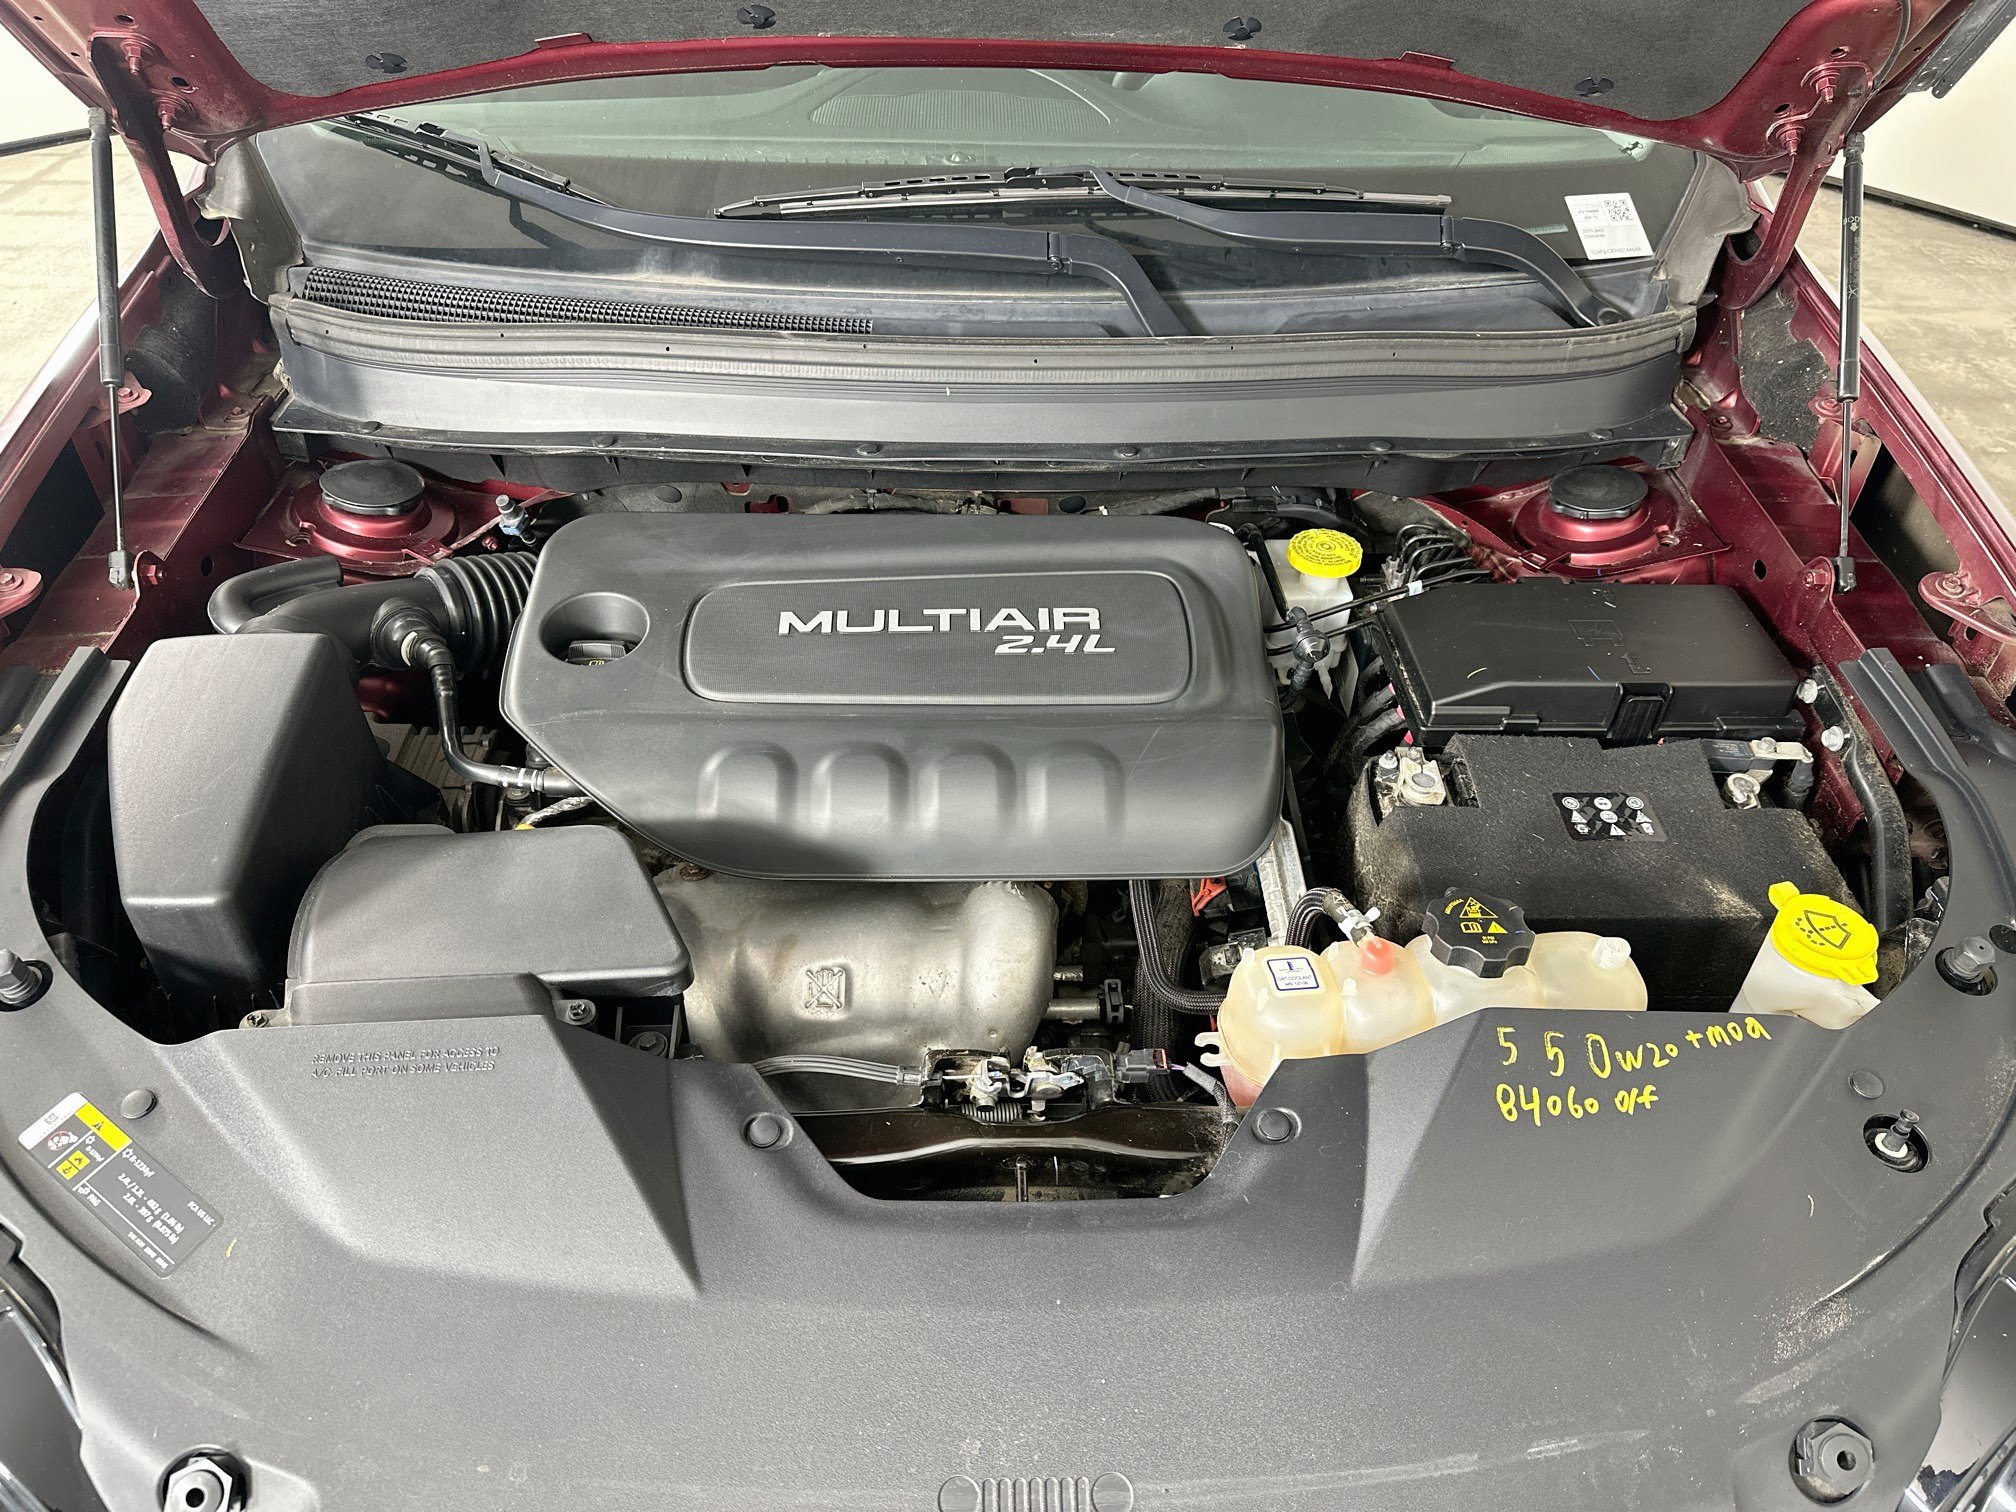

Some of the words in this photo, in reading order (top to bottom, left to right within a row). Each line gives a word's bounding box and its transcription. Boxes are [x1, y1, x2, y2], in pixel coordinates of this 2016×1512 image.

[778, 607, 1101, 636] MULTIAIR
[994, 634, 1116, 655] 2.4L
[311, 1052, 355, 1064] REMOVE
[358, 1051, 382, 1062] THIS
[383, 1050, 416, 1061] PANEL
[419, 1049, 440, 1060] FOR
[441, 1047, 483, 1058] ACCESS
[485, 1046, 500, 1057] TO
[1496, 1027, 1518, 1066] 5
[1544, 1031, 1565, 1077] 5
[335, 1066, 356, 1077] FILL
[360, 1065, 389, 1076] PORT
[391, 1063, 409, 1075] ON
[410, 1062, 441, 1074] SOME
[444, 1060, 496, 1072] VEHICLES
